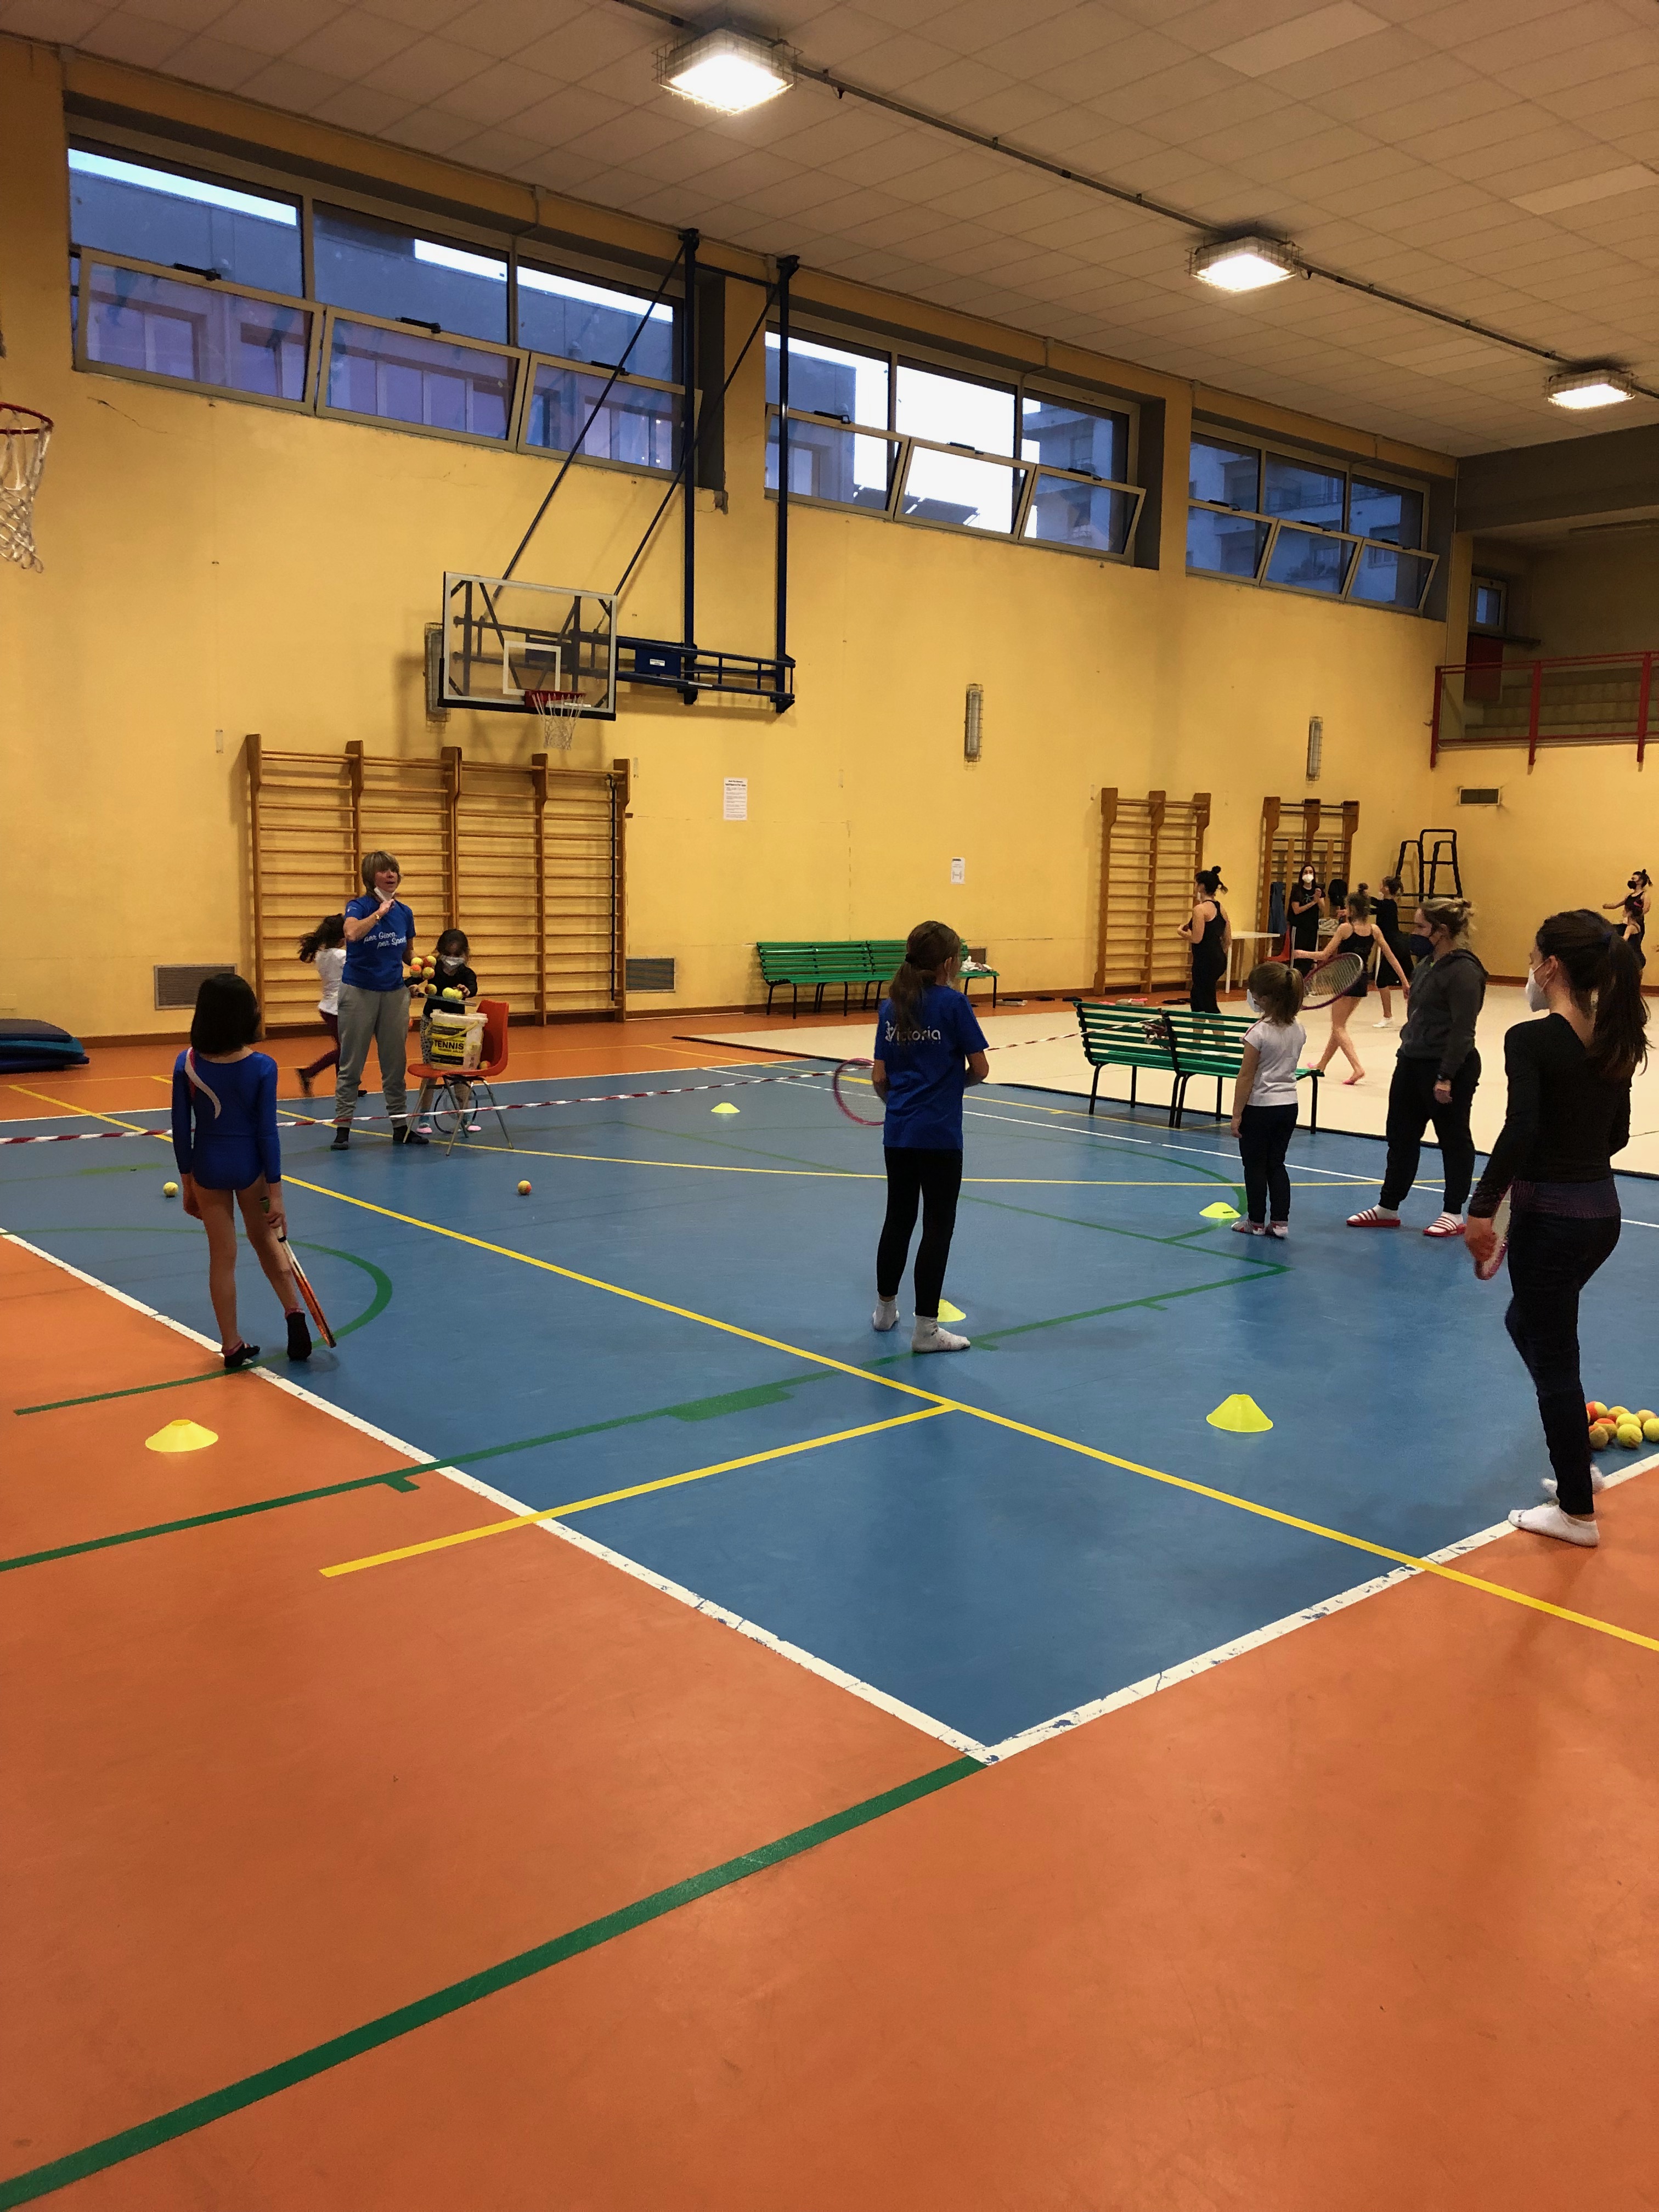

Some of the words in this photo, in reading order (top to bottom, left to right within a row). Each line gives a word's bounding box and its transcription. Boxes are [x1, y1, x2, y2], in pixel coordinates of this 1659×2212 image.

[364, 935, 377, 944] per
[377, 941, 390, 949] per
[435, 1040, 464, 1050] TENNIS
